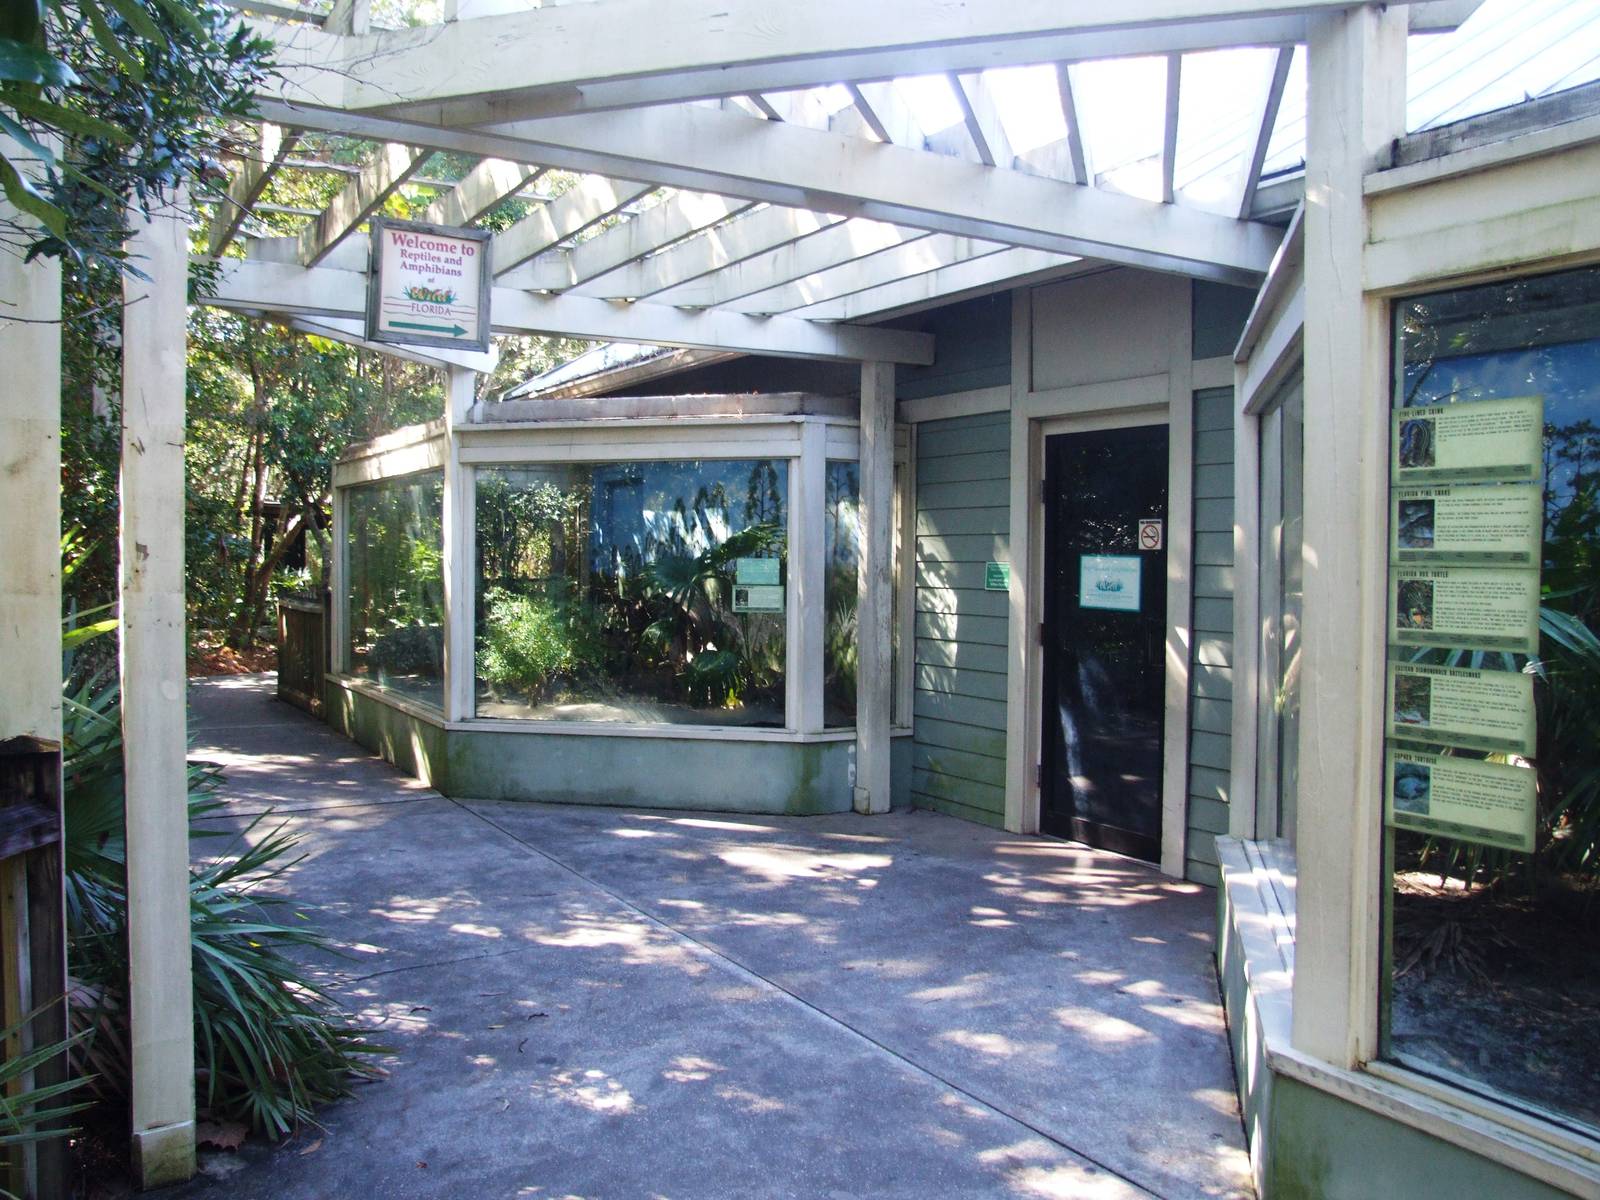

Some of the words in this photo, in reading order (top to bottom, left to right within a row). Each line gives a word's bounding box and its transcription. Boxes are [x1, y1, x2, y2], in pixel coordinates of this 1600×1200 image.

[391, 232, 457, 254] Welcome
[461, 243, 475, 257] to
[400, 248, 441, 263] Reptiles
[444, 256, 463, 266] and
[400, 261, 462, 277] Amphibians
[411, 303, 452, 316] FLORIDA
